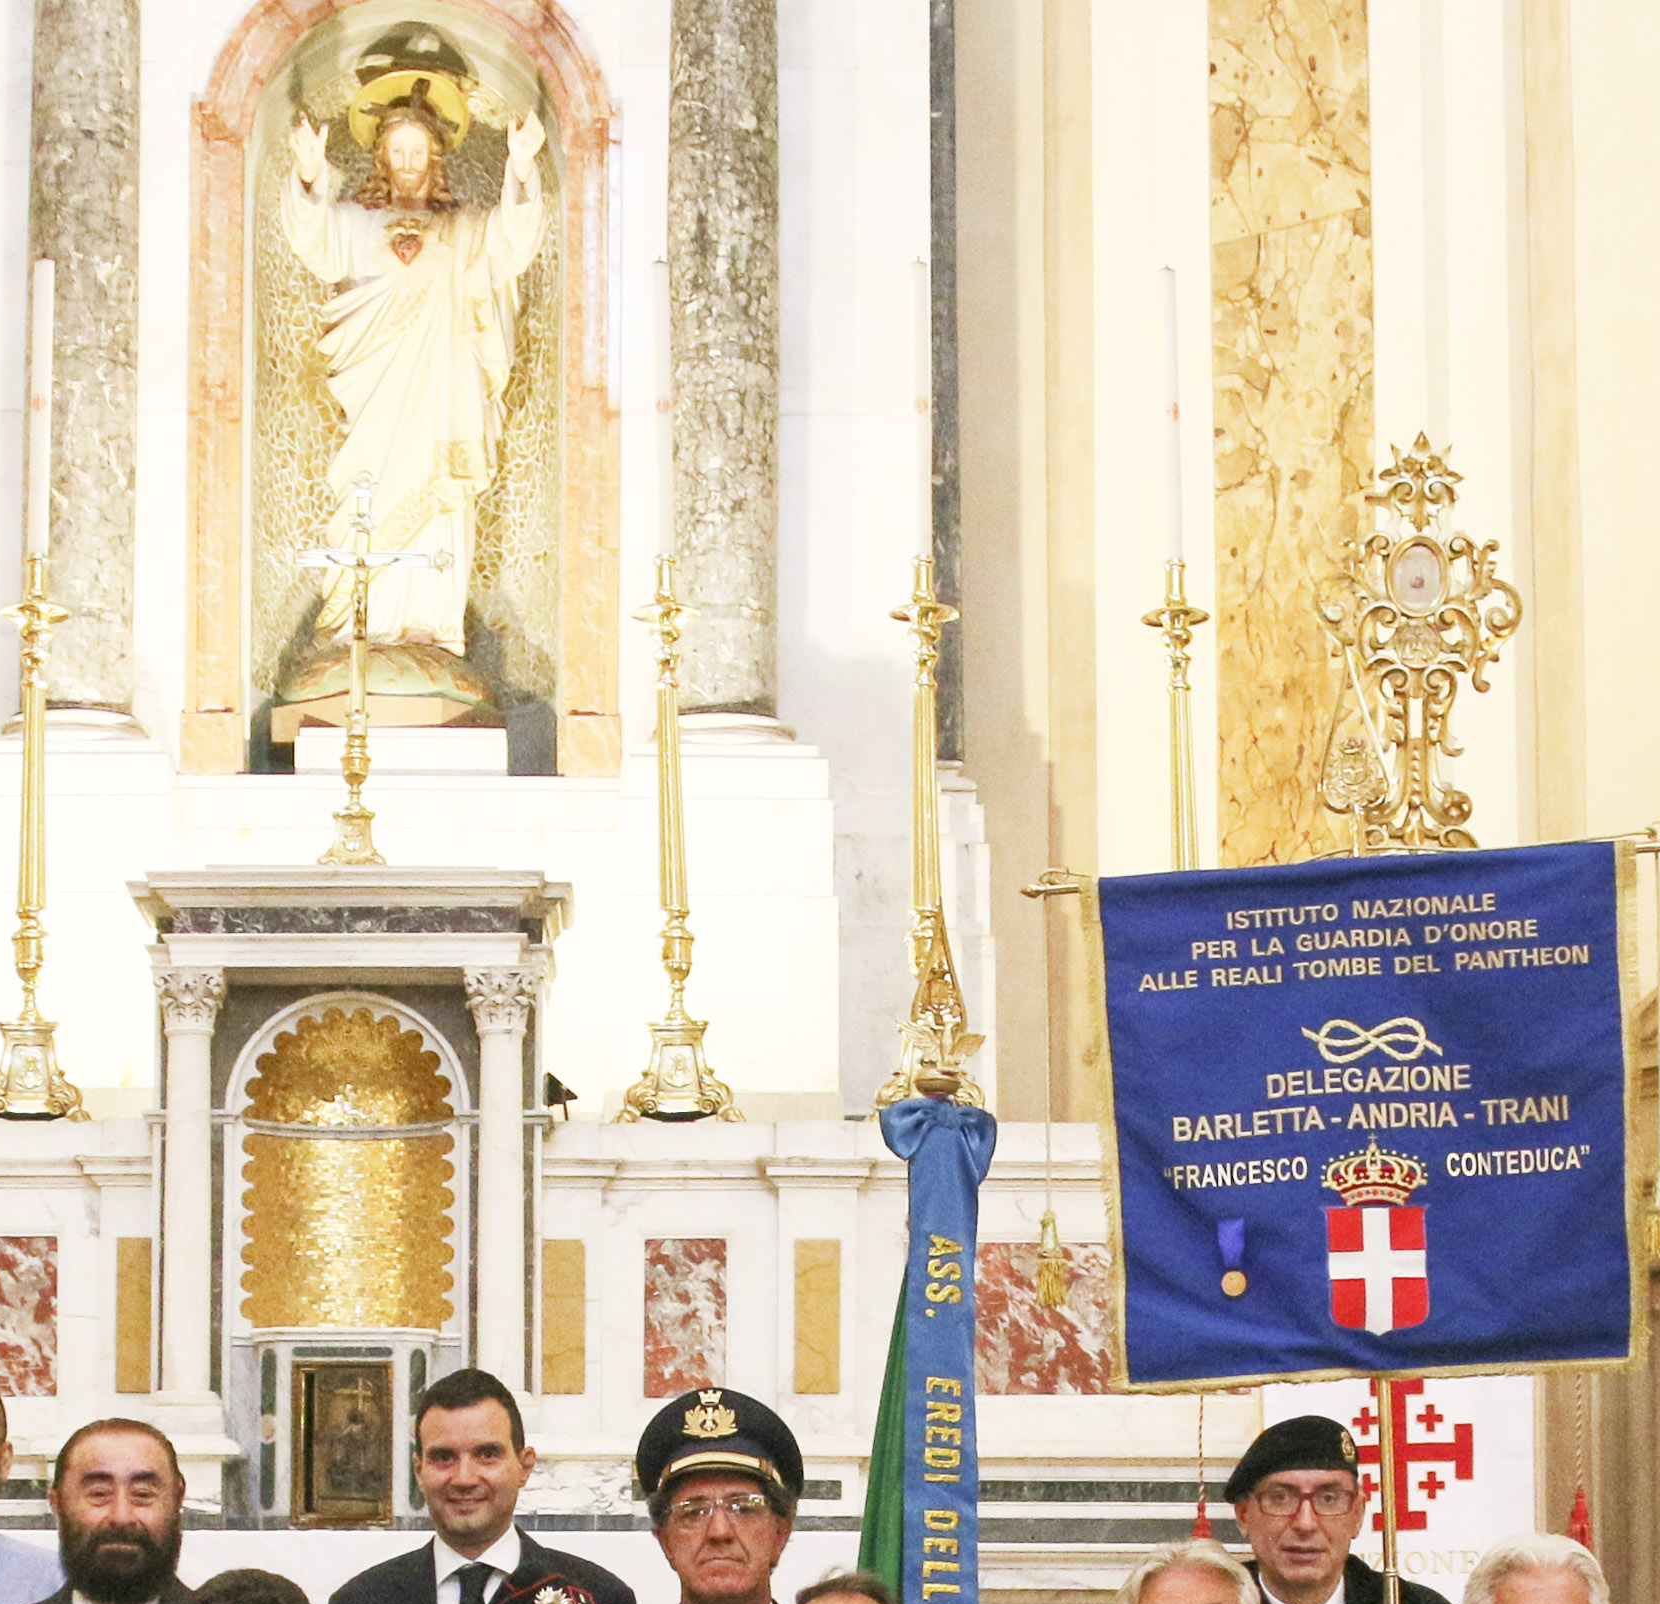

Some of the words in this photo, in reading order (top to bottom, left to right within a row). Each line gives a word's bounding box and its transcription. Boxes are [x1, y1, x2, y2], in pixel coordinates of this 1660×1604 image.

[1227, 904, 1343, 931] ISTITUTO
[1352, 893, 1496, 918] NAZIONALE
[1191, 940, 1237, 960] PER
[1251, 937, 1285, 956] LA
[1295, 928, 1411, 952] GUARDIA
[1423, 919, 1538, 943] D'ONORE
[1138, 970, 1198, 992] ALLE
[1211, 965, 1282, 987] REALI
[1292, 957, 1382, 980] TOMBE
[1394, 955, 1441, 974] DEL
[1455, 945, 1589, 970] PANTHEON
[1266, 1064, 1472, 1099] DELEGAZIONE
[1173, 1106, 1325, 1142] BARLETTA
[1347, 1102, 1458, 1129] ANDRIA
[1480, 1095, 1568, 1125] TRANI
[925, 1234, 963, 1317] ASS.
[924, 1377, 962, 1482] EREDI
